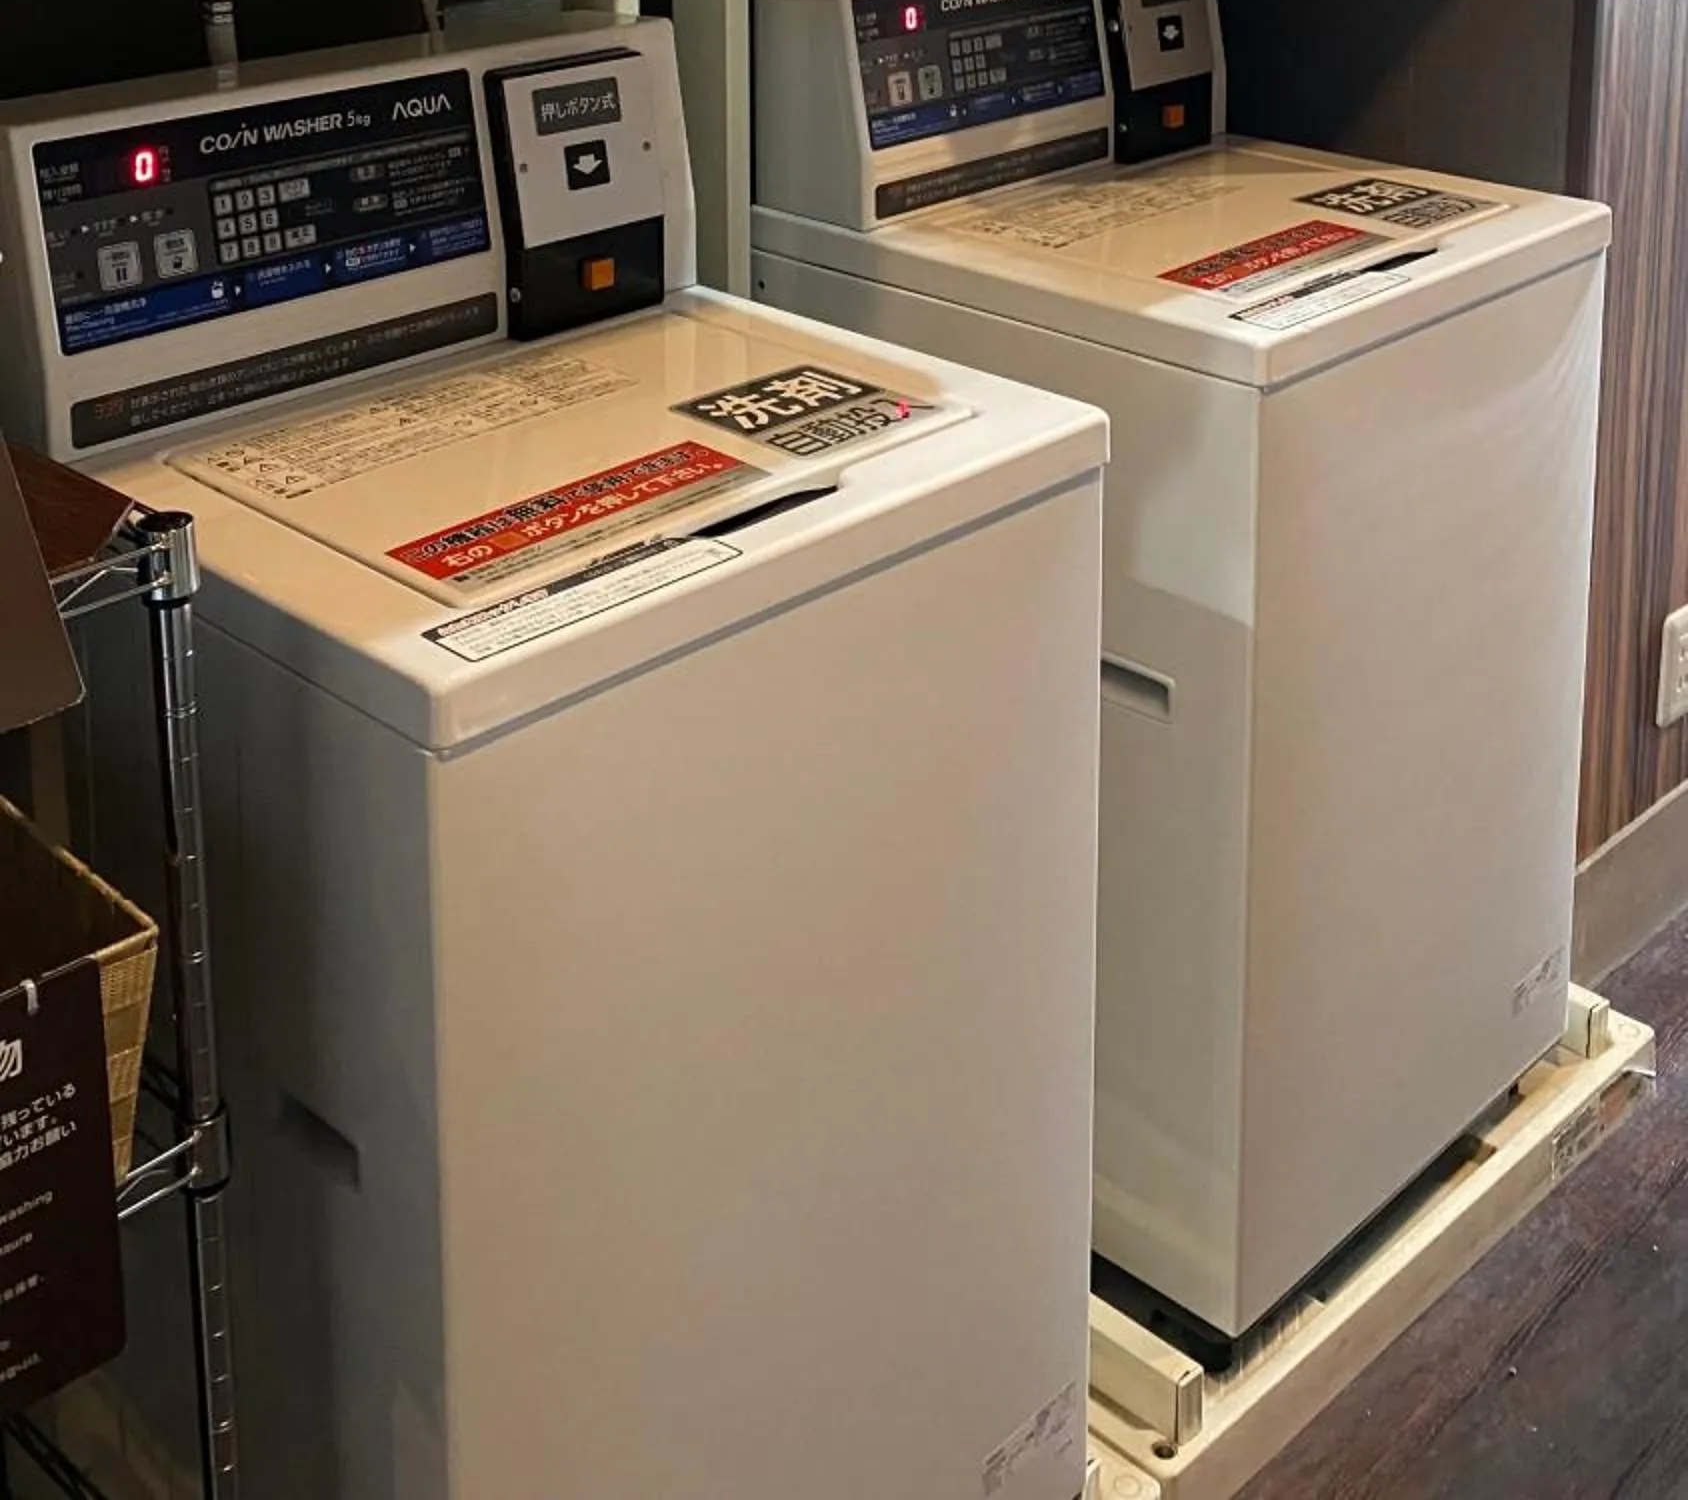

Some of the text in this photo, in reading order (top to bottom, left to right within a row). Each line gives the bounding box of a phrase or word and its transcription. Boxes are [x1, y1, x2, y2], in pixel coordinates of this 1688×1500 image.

[904, 6, 918, 30] 0
[263, 112, 343, 144] WASHER
[346, 110, 371, 129] 5kg
[392, 93, 452, 122] AQUA
[540, 92, 616, 122] 押しボタン式
[135, 151, 154, 182] 0
[697, 371, 864, 430] 洗剤
[766, 398, 936, 457] 自動投入
[440, 462, 724, 567] 右の ボタンを押して下さい。
